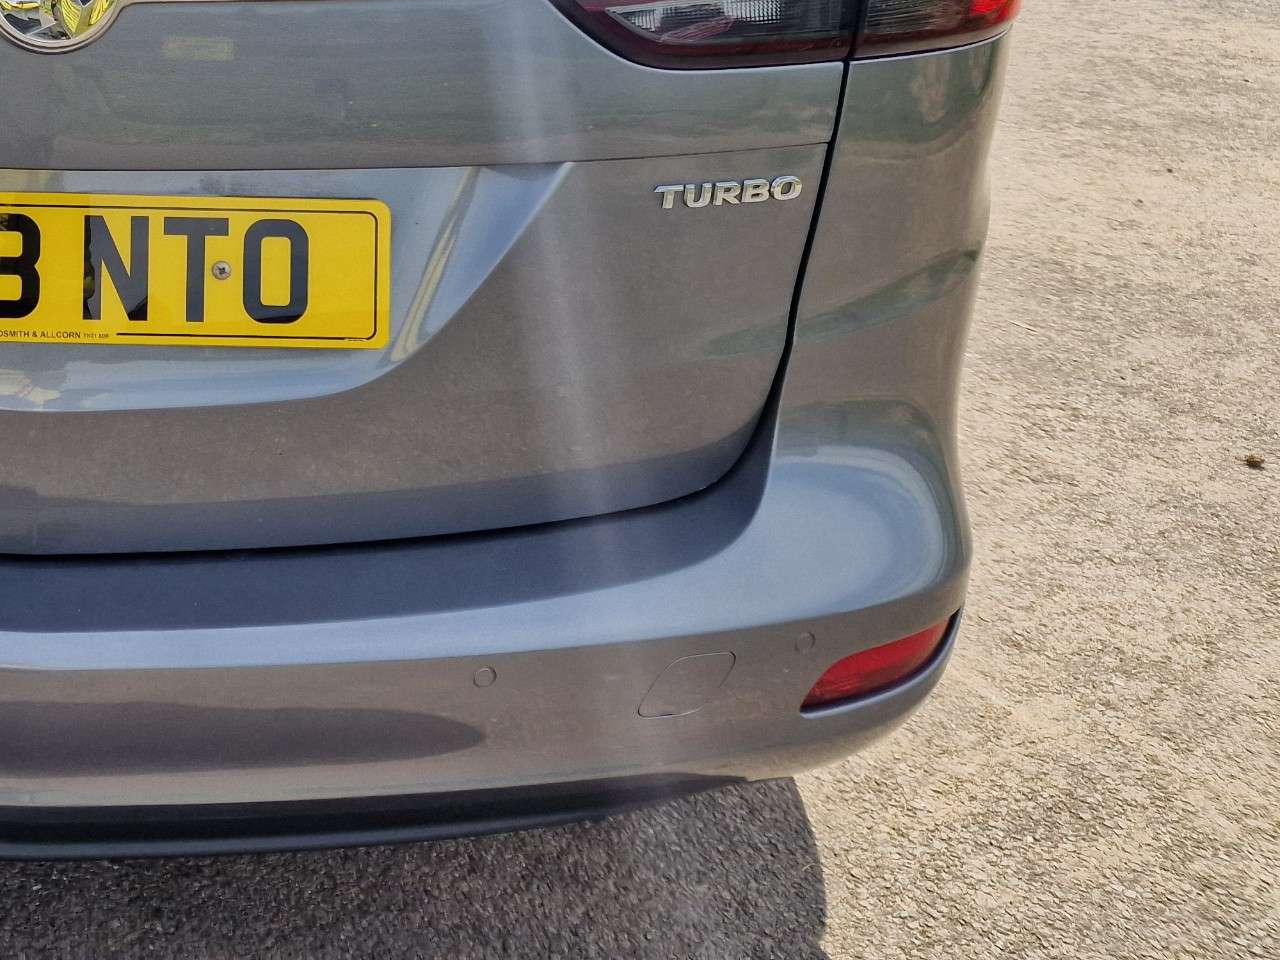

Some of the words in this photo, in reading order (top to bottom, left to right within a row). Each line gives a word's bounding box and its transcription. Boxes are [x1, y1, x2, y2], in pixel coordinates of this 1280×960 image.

[653, 175, 803, 209] TURBO
[83, 214, 311, 324] NTO
[31, 330, 38, 338] &
[39, 331, 81, 339] ALLCORN
